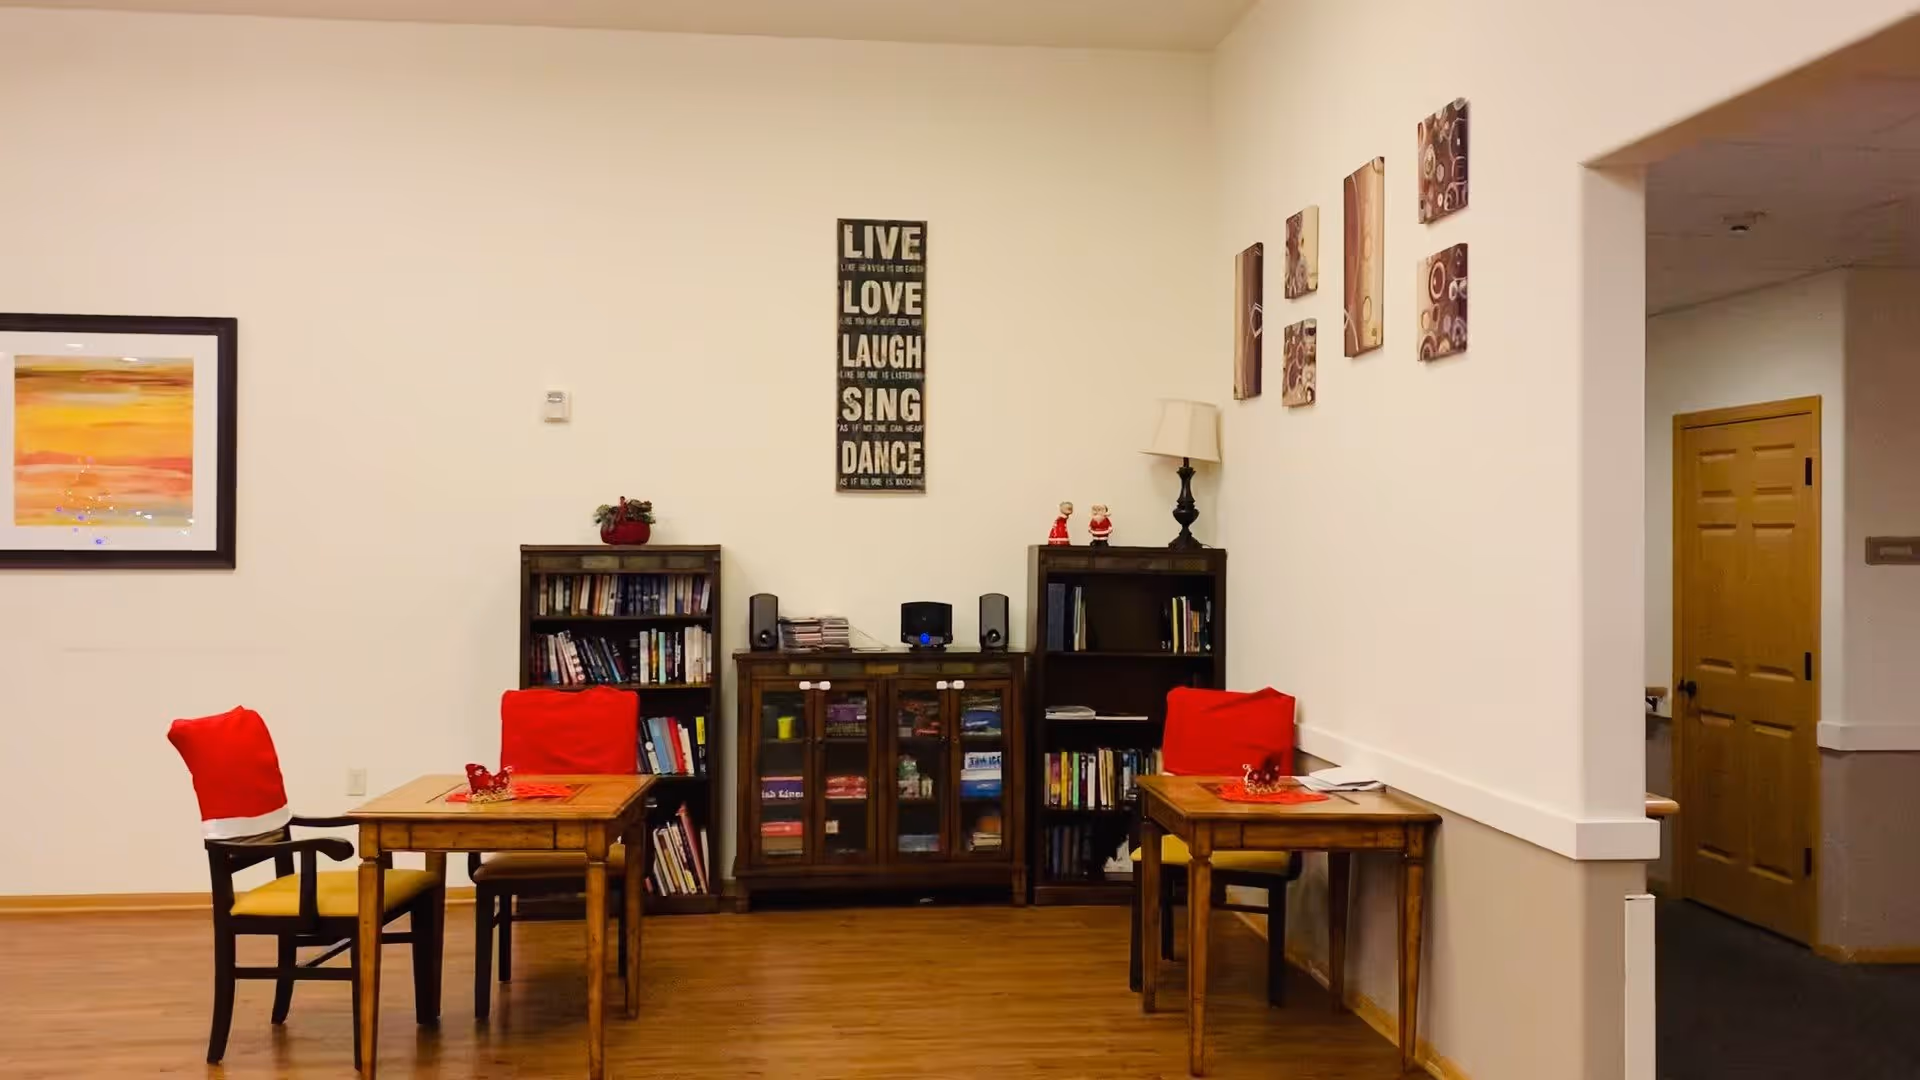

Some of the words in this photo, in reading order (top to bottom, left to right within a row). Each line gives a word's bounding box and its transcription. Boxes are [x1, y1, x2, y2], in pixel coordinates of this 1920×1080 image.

[843, 224, 921, 260] LIVE
[843, 280, 922, 315] LOVE
[842, 333, 922, 369] LAUGH
[842, 386, 921, 422] SING
[842, 440, 922, 475] DANCE
